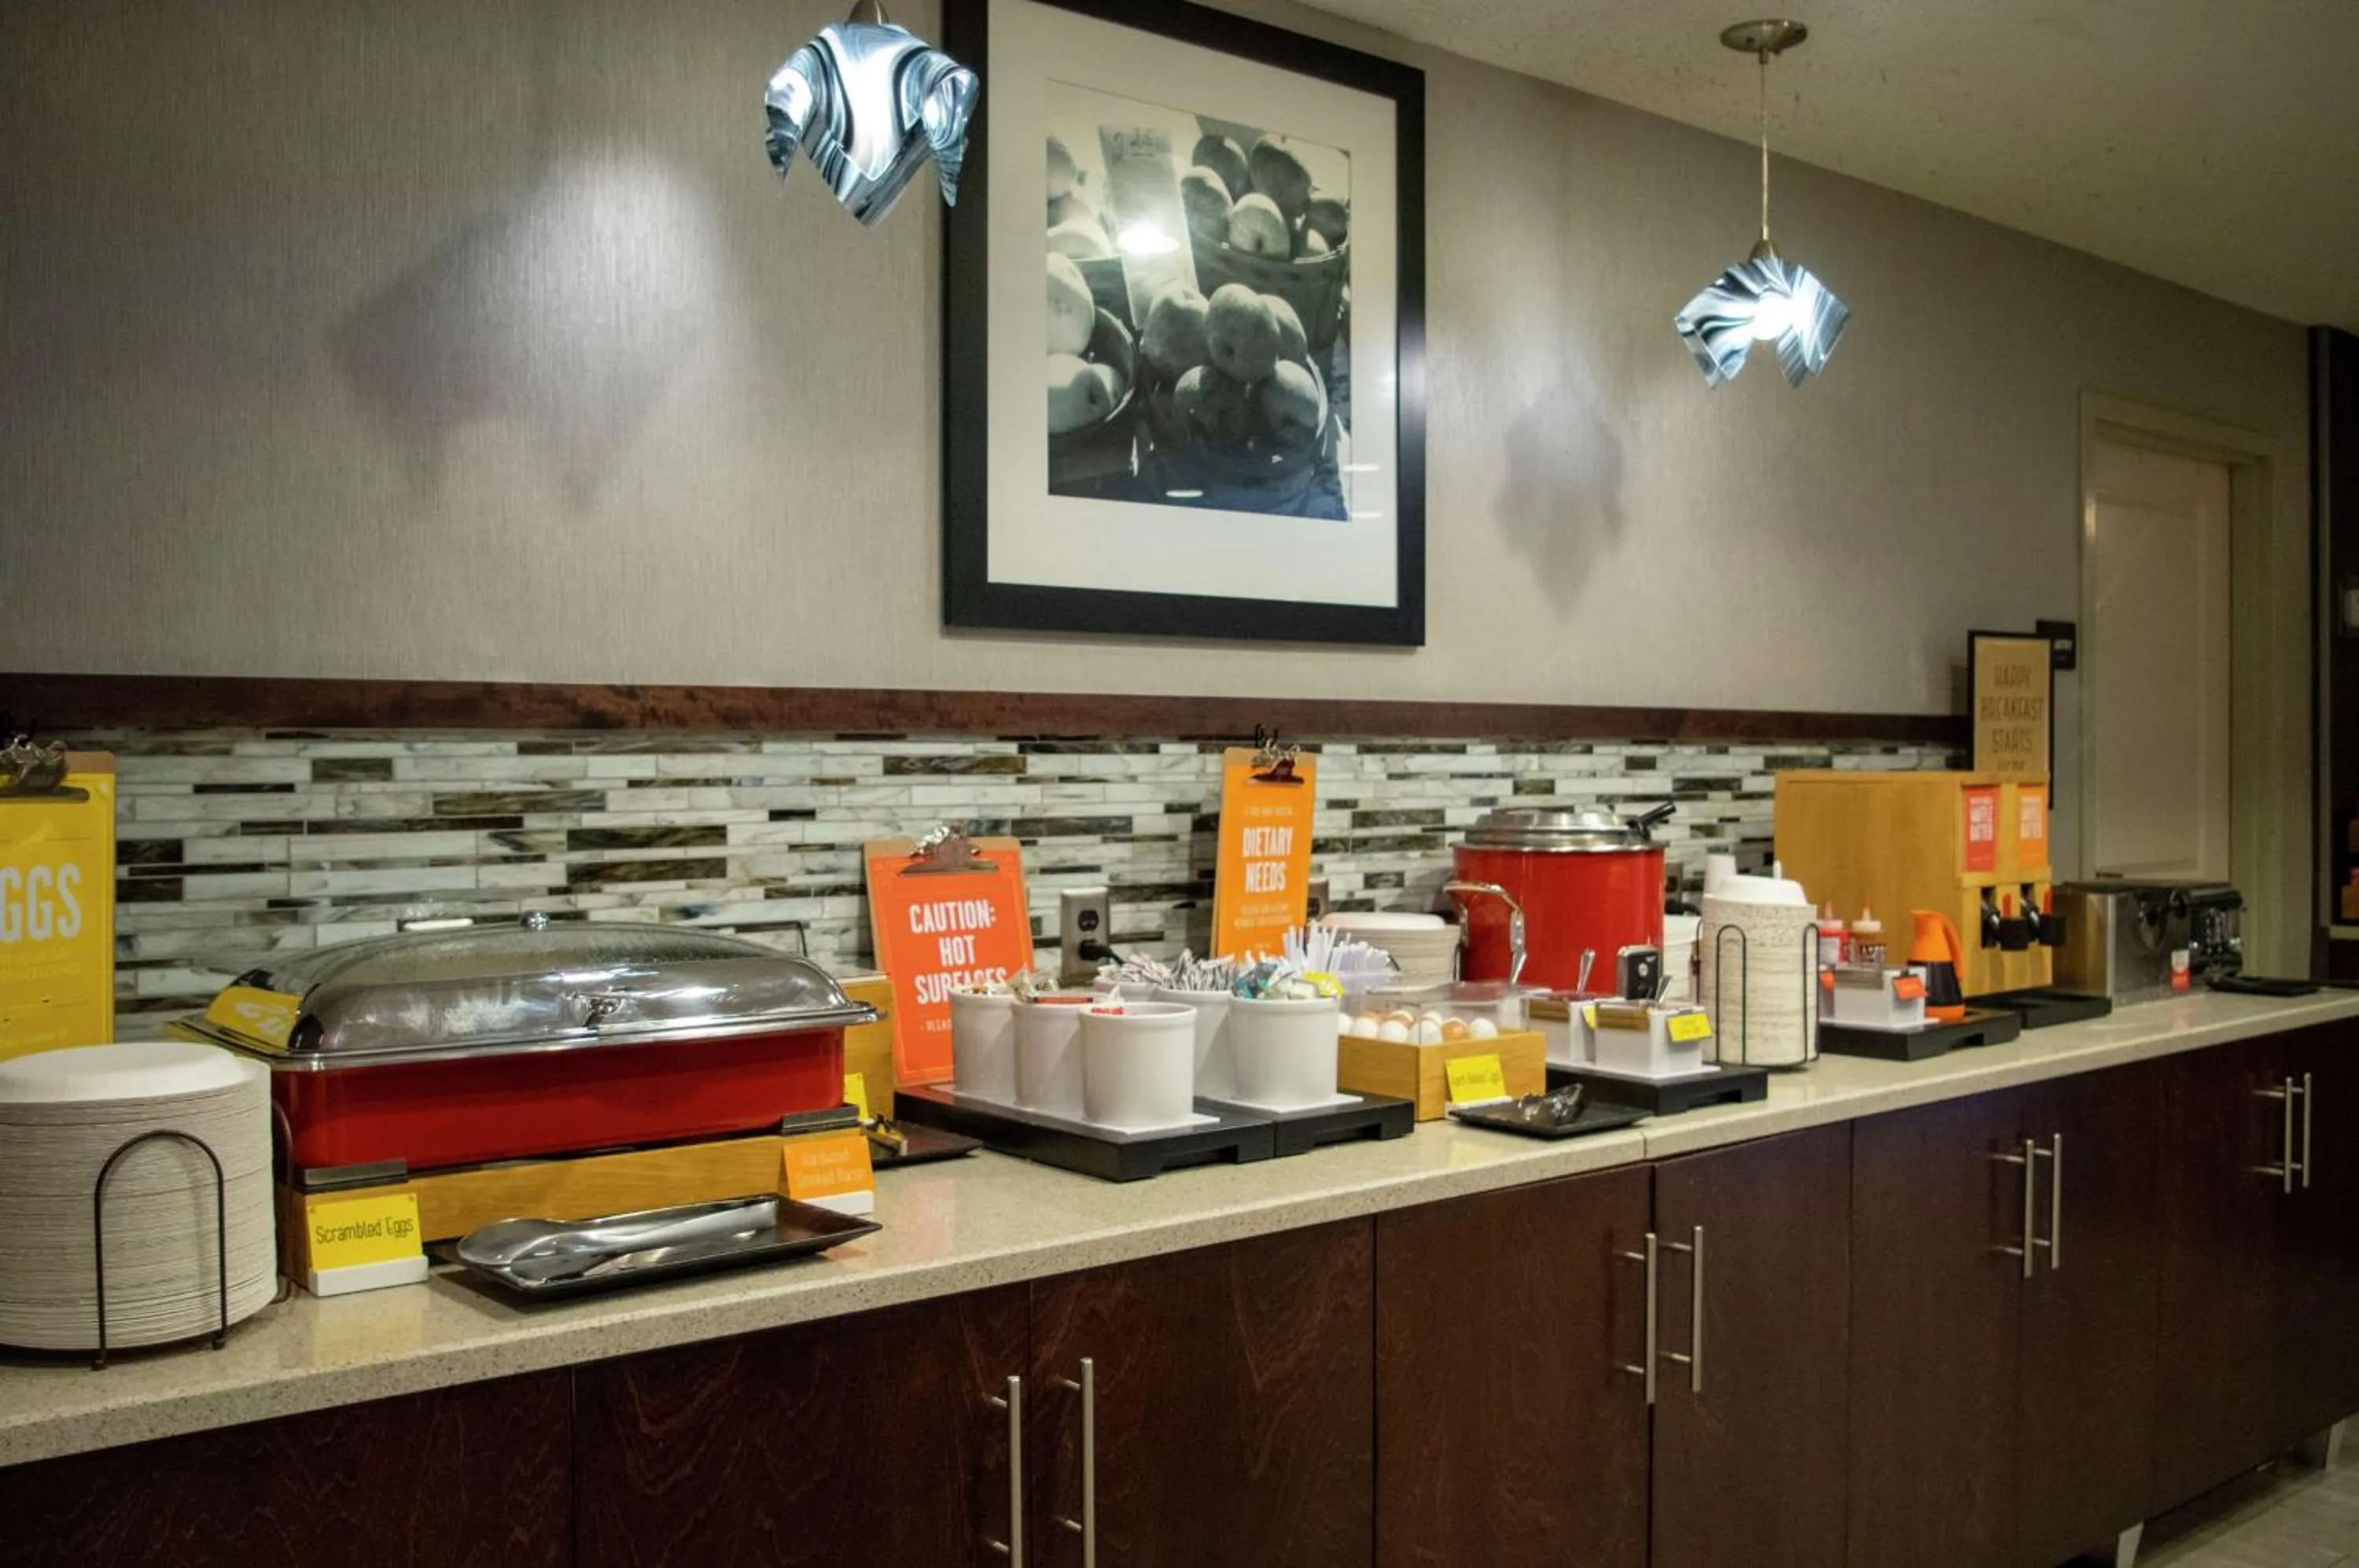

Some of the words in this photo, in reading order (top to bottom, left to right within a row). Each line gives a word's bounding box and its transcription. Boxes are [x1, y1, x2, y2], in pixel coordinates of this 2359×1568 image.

[1242, 827, 1293, 857] DIETARY
[1246, 862, 1286, 893] NEEDS
[909, 900, 996, 933] CAUTION:
[938, 935, 976, 967] HOT
[315, 1220, 382, 1244] Scrambled
[386, 1216, 414, 1239] Eggs
